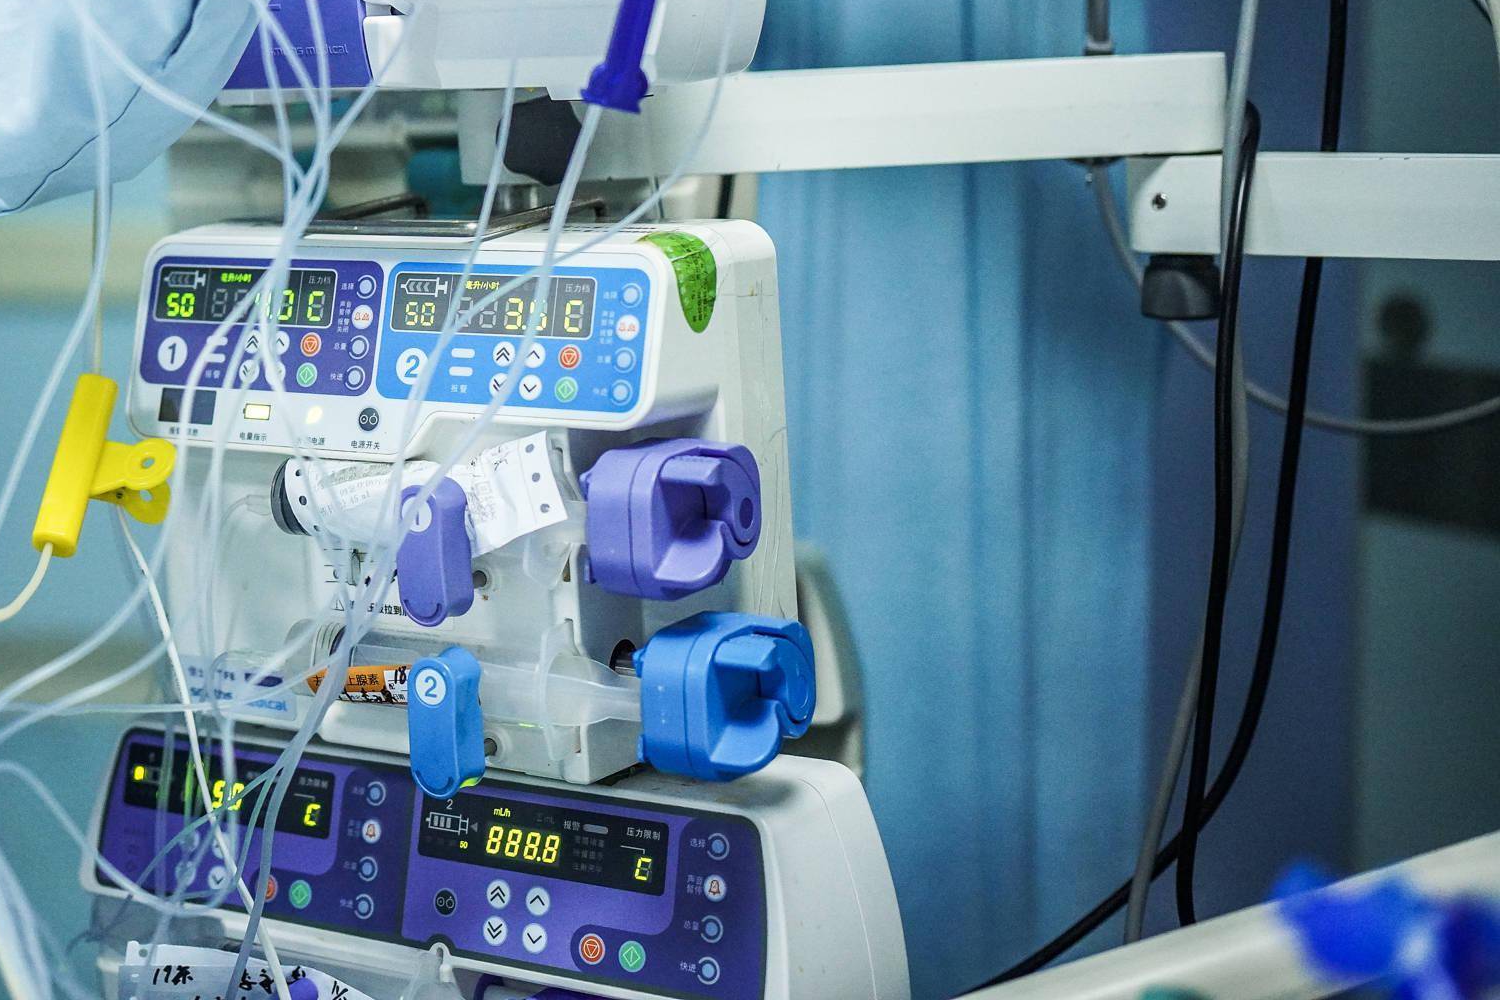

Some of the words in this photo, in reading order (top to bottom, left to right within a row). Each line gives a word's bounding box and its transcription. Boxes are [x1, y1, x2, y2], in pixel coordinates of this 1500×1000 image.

[465, 280, 500, 291] 毫升/小时
[564, 284, 591, 294] 压力档
[166, 292, 196, 317] 50
[405, 301, 436, 327] 50
[167, 342, 177, 365] 1
[404, 354, 421, 379] 2
[239, 432, 267, 442] 电量指示
[350, 440, 381, 450] 电源开关
[424, 675, 439, 698] 2
[446, 798, 454, 810] 2
[563, 820, 581, 832] 报警
[626, 827, 661, 841] 压力限制
[459, 840, 468, 850] 50
[485, 825, 560, 864] 888.8
[679, 960, 697, 973] 快进
